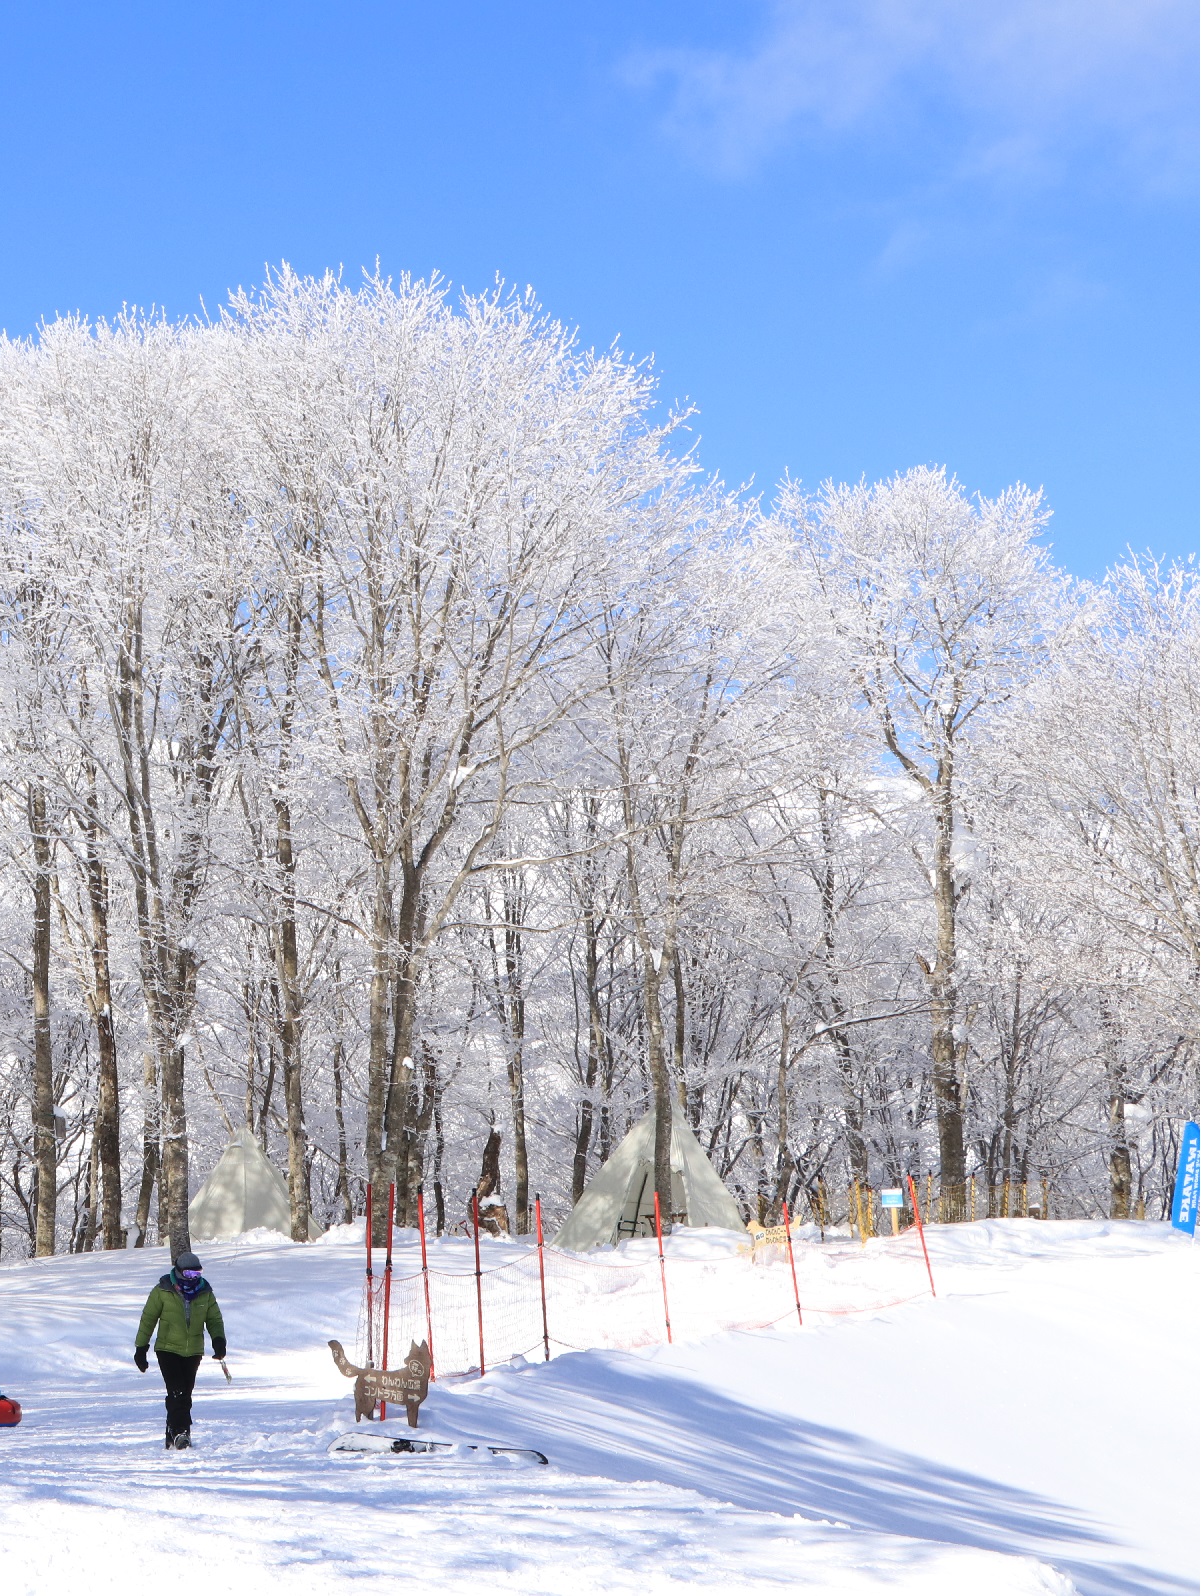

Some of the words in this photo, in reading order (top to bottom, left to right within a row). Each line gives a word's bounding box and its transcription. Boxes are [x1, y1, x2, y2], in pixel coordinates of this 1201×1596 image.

[381, 1375, 421, 1391] わんわん広場
